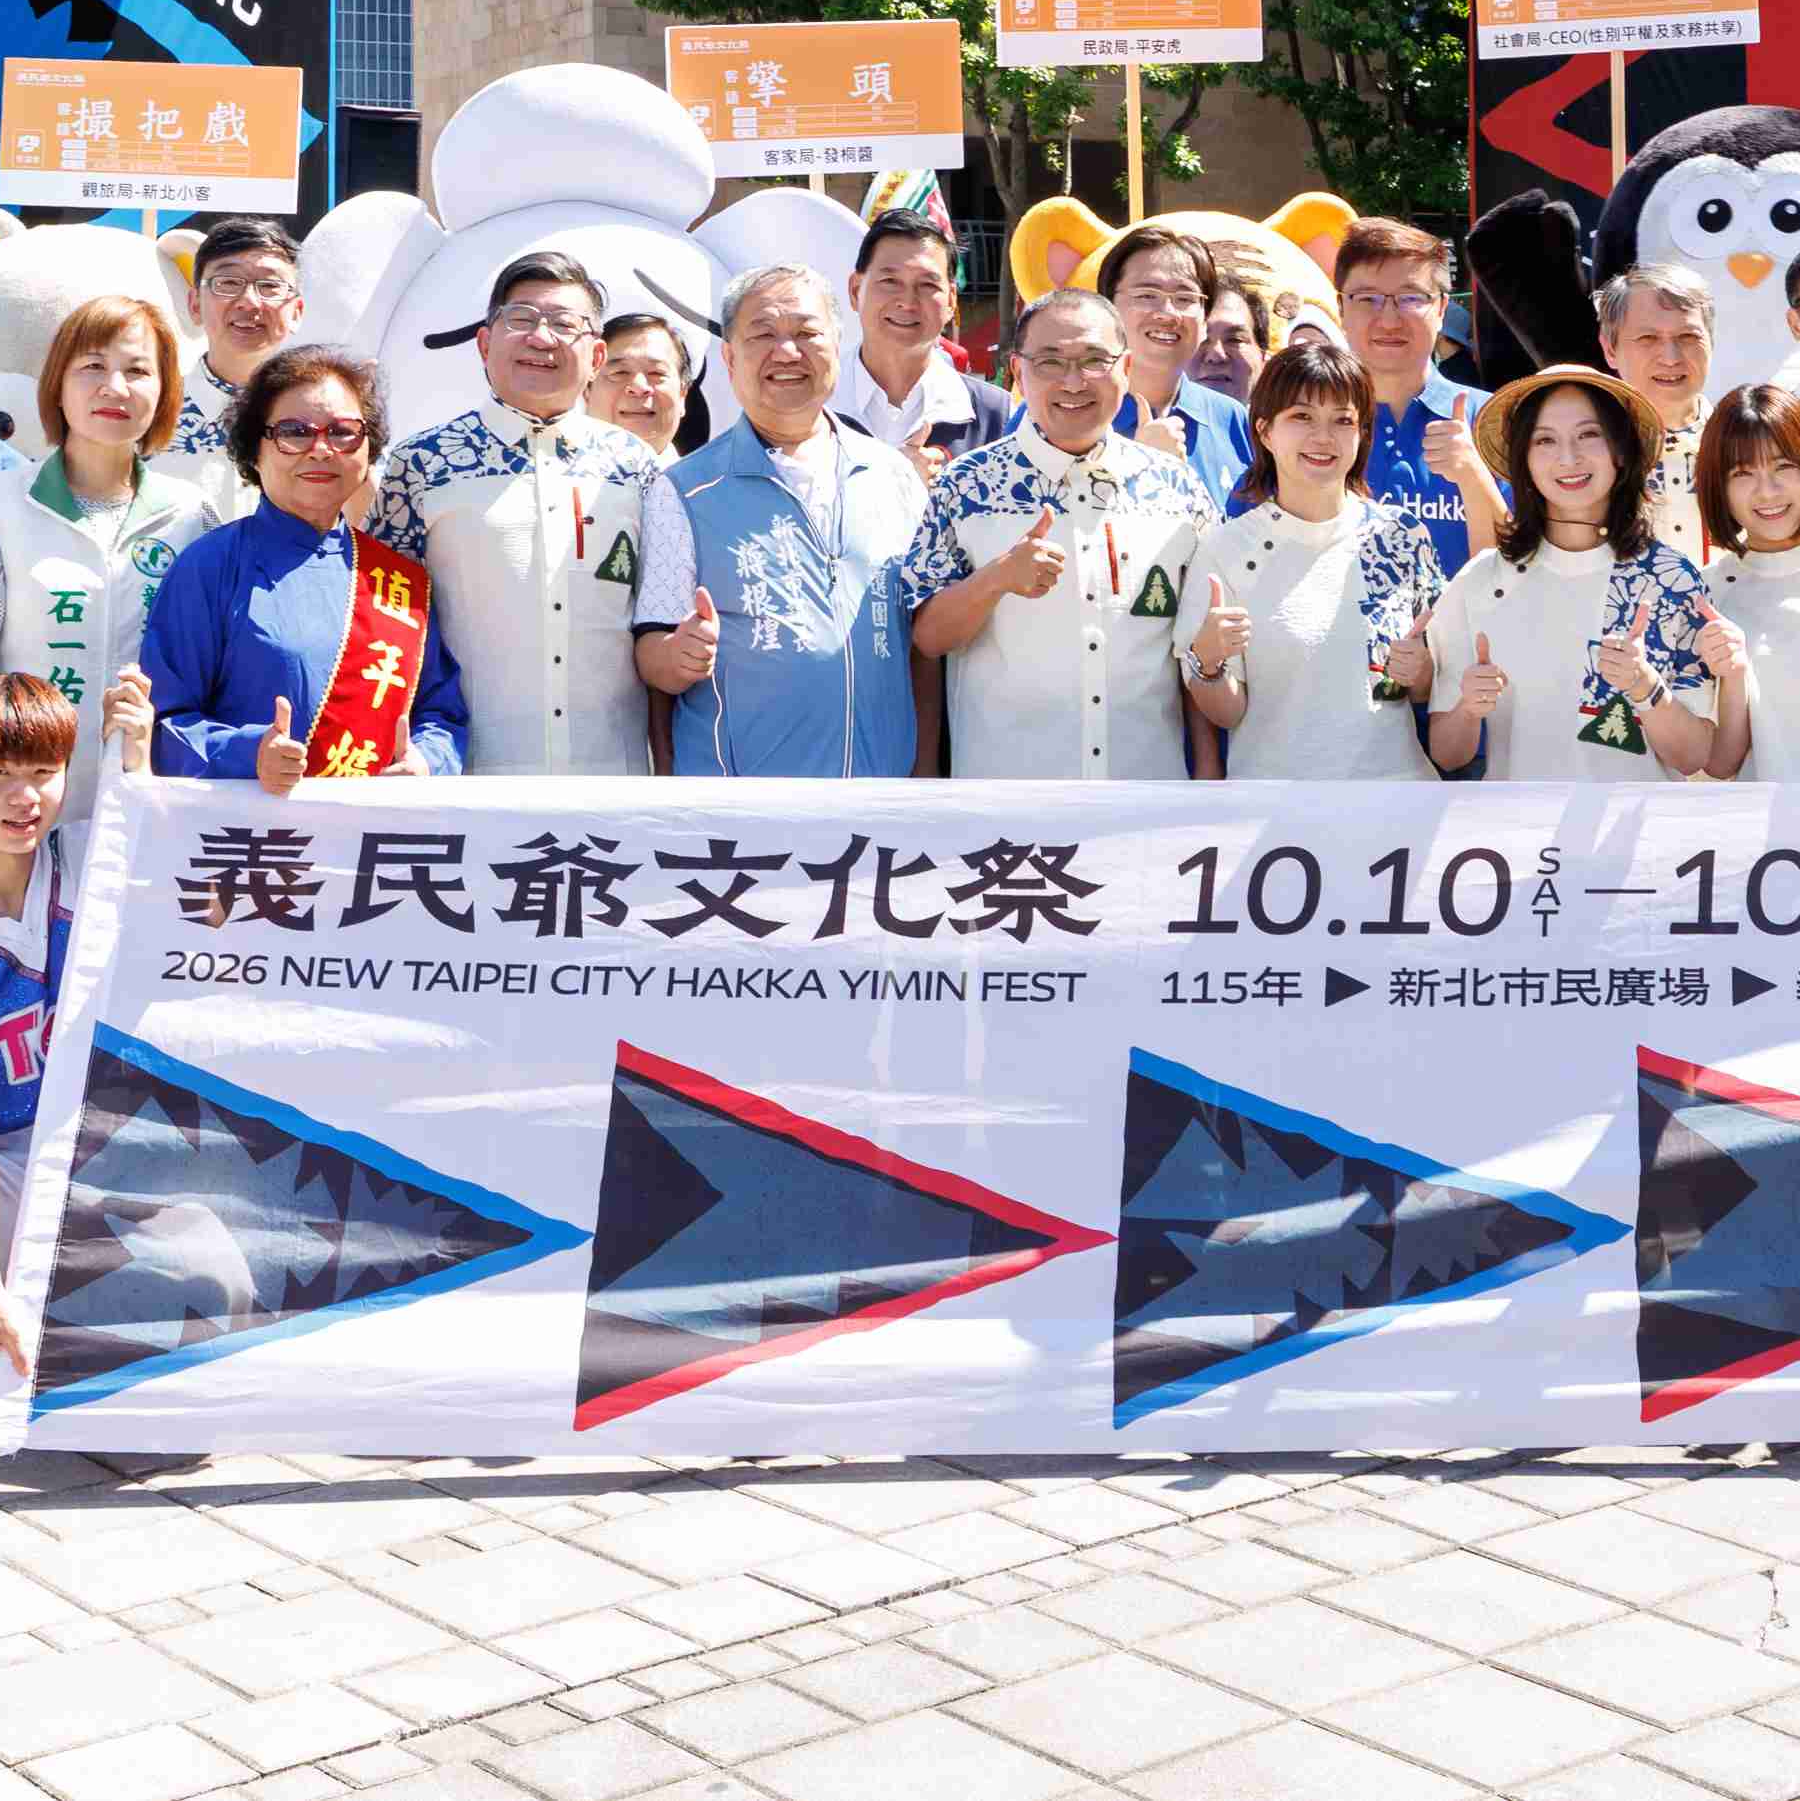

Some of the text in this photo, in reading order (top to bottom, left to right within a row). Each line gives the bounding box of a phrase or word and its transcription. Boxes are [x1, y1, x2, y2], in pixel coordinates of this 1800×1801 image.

[1082, 38, 1183, 57] 民政局-平安虎
[71, 96, 250, 147] 撮把戲
[81, 181, 212, 202] 觀旅局-新北小客
[175, 827, 1104, 944] 義民爺文化祭
[1167, 846, 1512, 936] 10.10
[1531, 847, 1561, 937] SAT
[161, 951, 1087, 1003] 2026 NEW TAIPEI CITY HAKKA YIMIN FEST
[1161, 965, 1304, 1006] 115年
[1387, 966, 1711, 1008] 新北市民廣場
